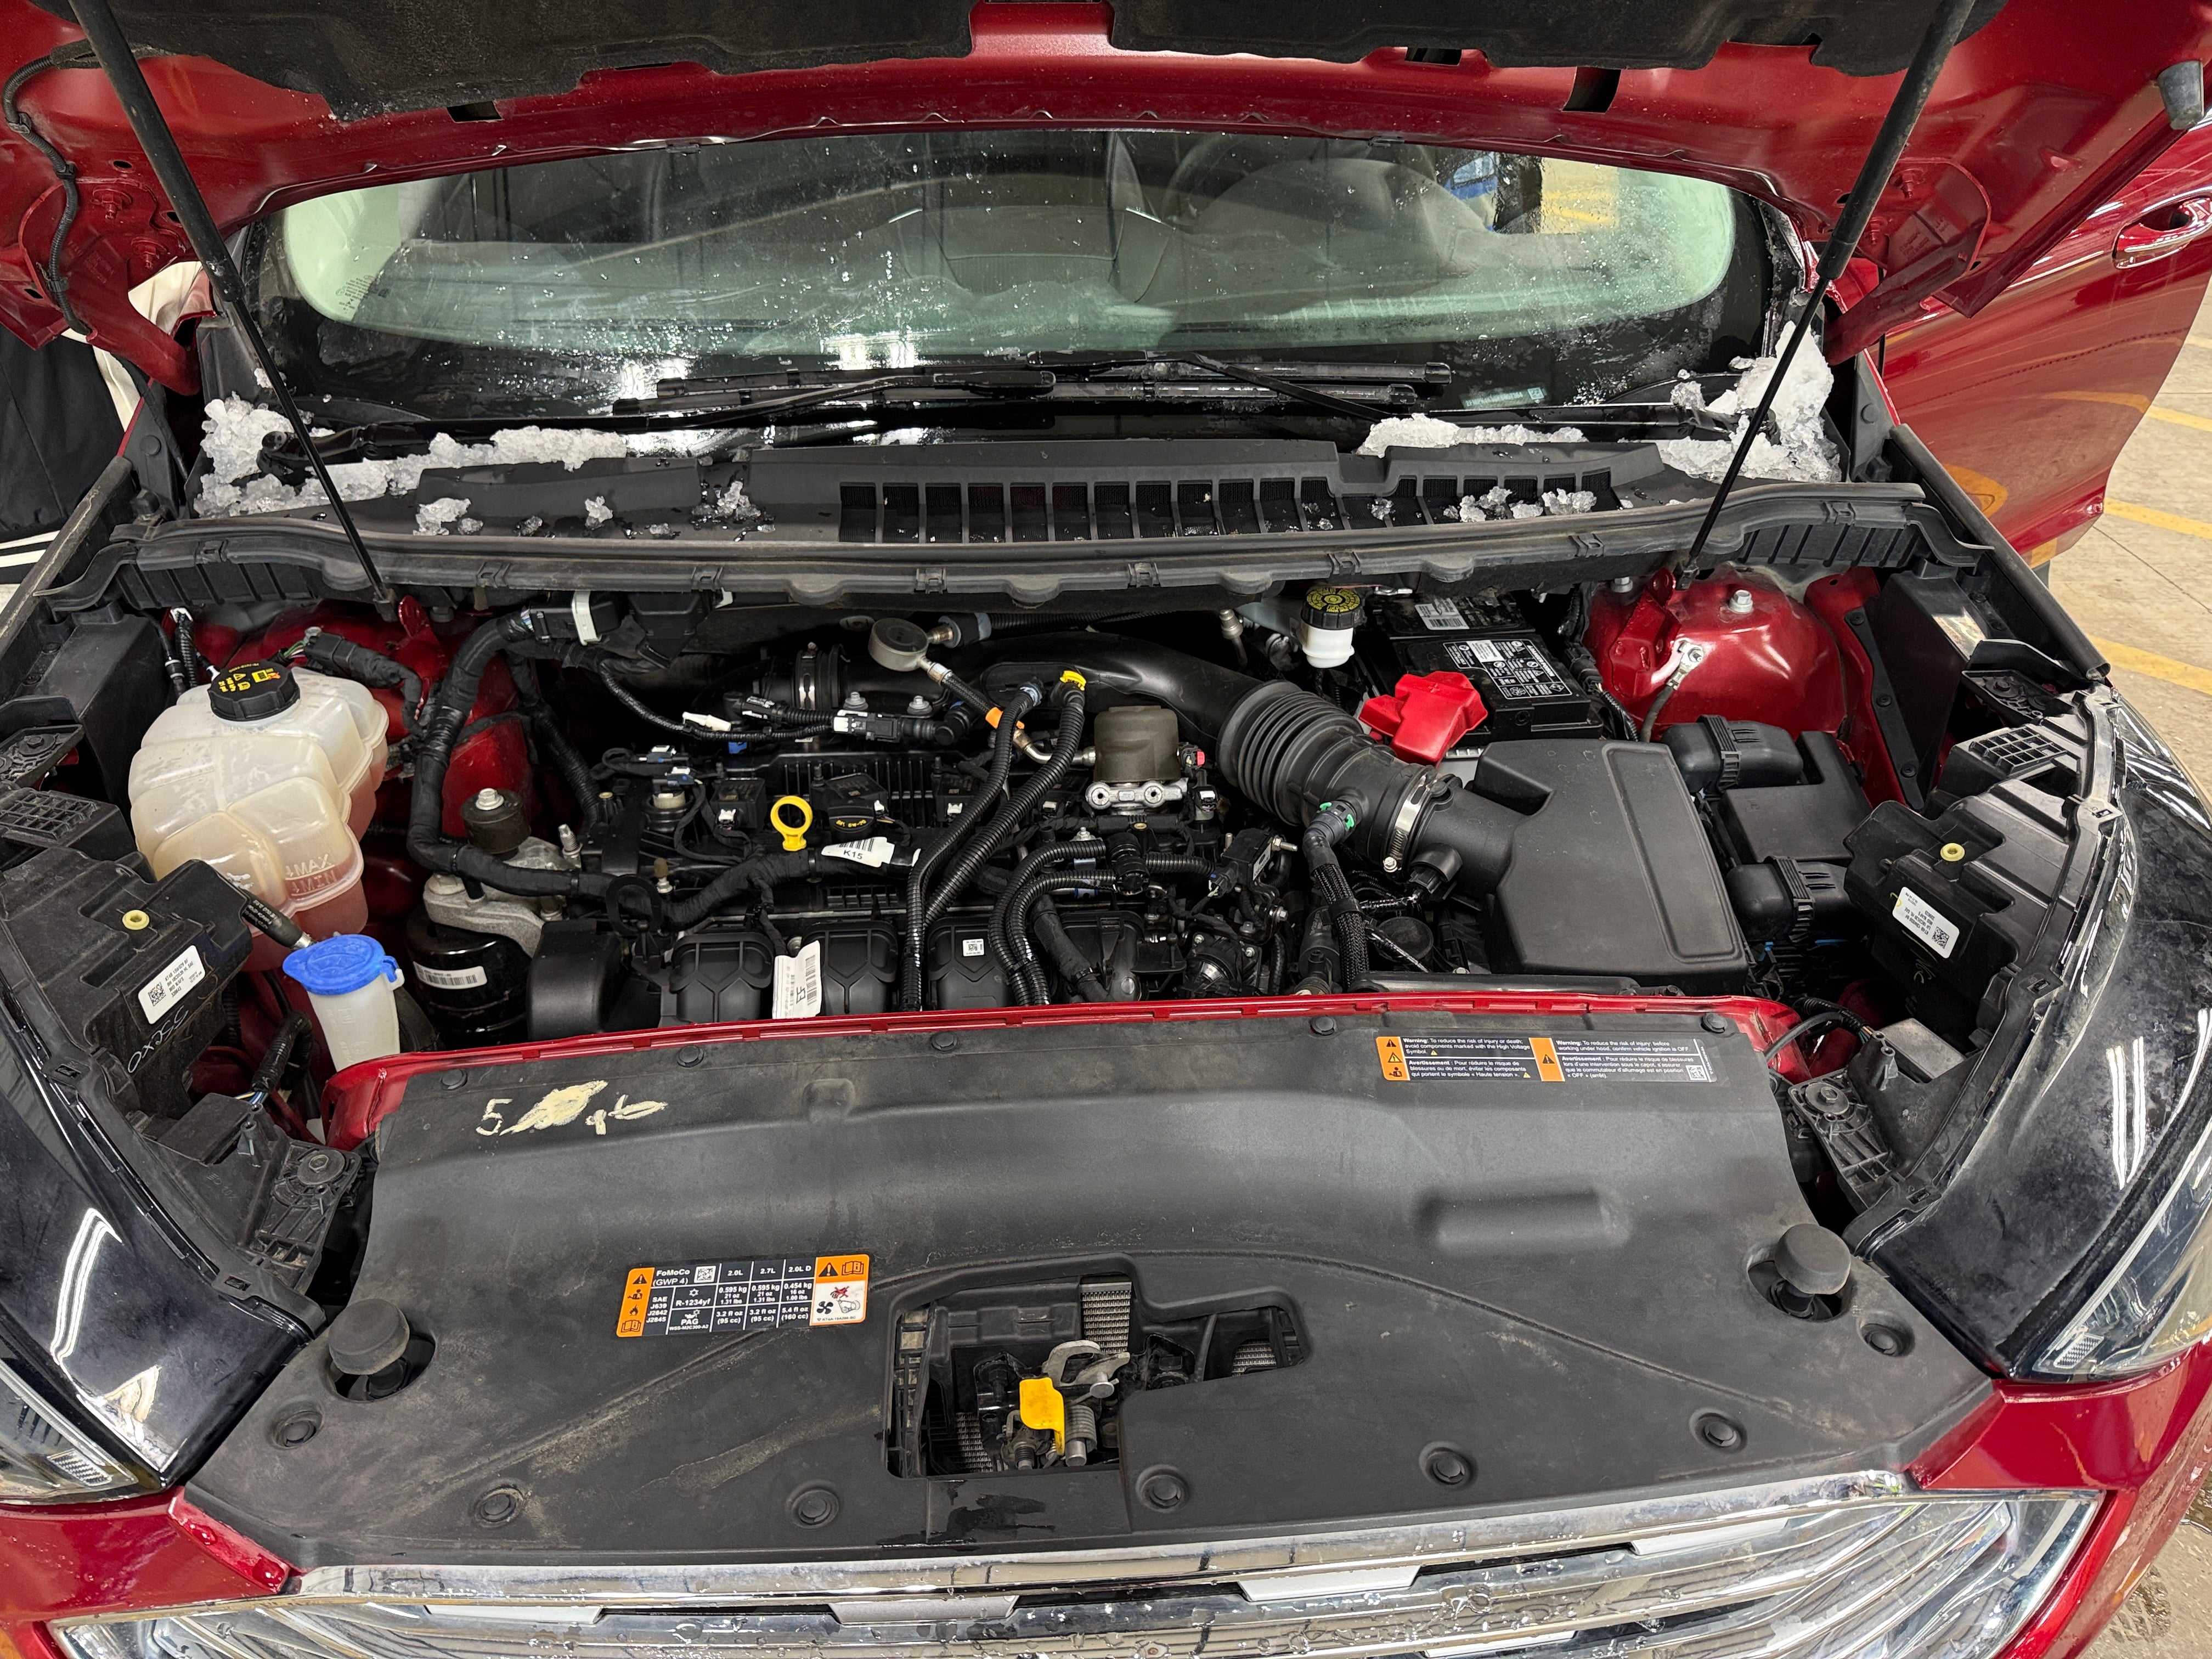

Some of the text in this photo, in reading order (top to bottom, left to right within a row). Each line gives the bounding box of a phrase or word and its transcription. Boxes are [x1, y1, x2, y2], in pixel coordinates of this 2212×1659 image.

[843, 850, 863, 860] K15
[294, 854, 331, 876] MAX
[300, 870, 337, 892] MIN
[653, 1278, 678, 1286] (GWP
